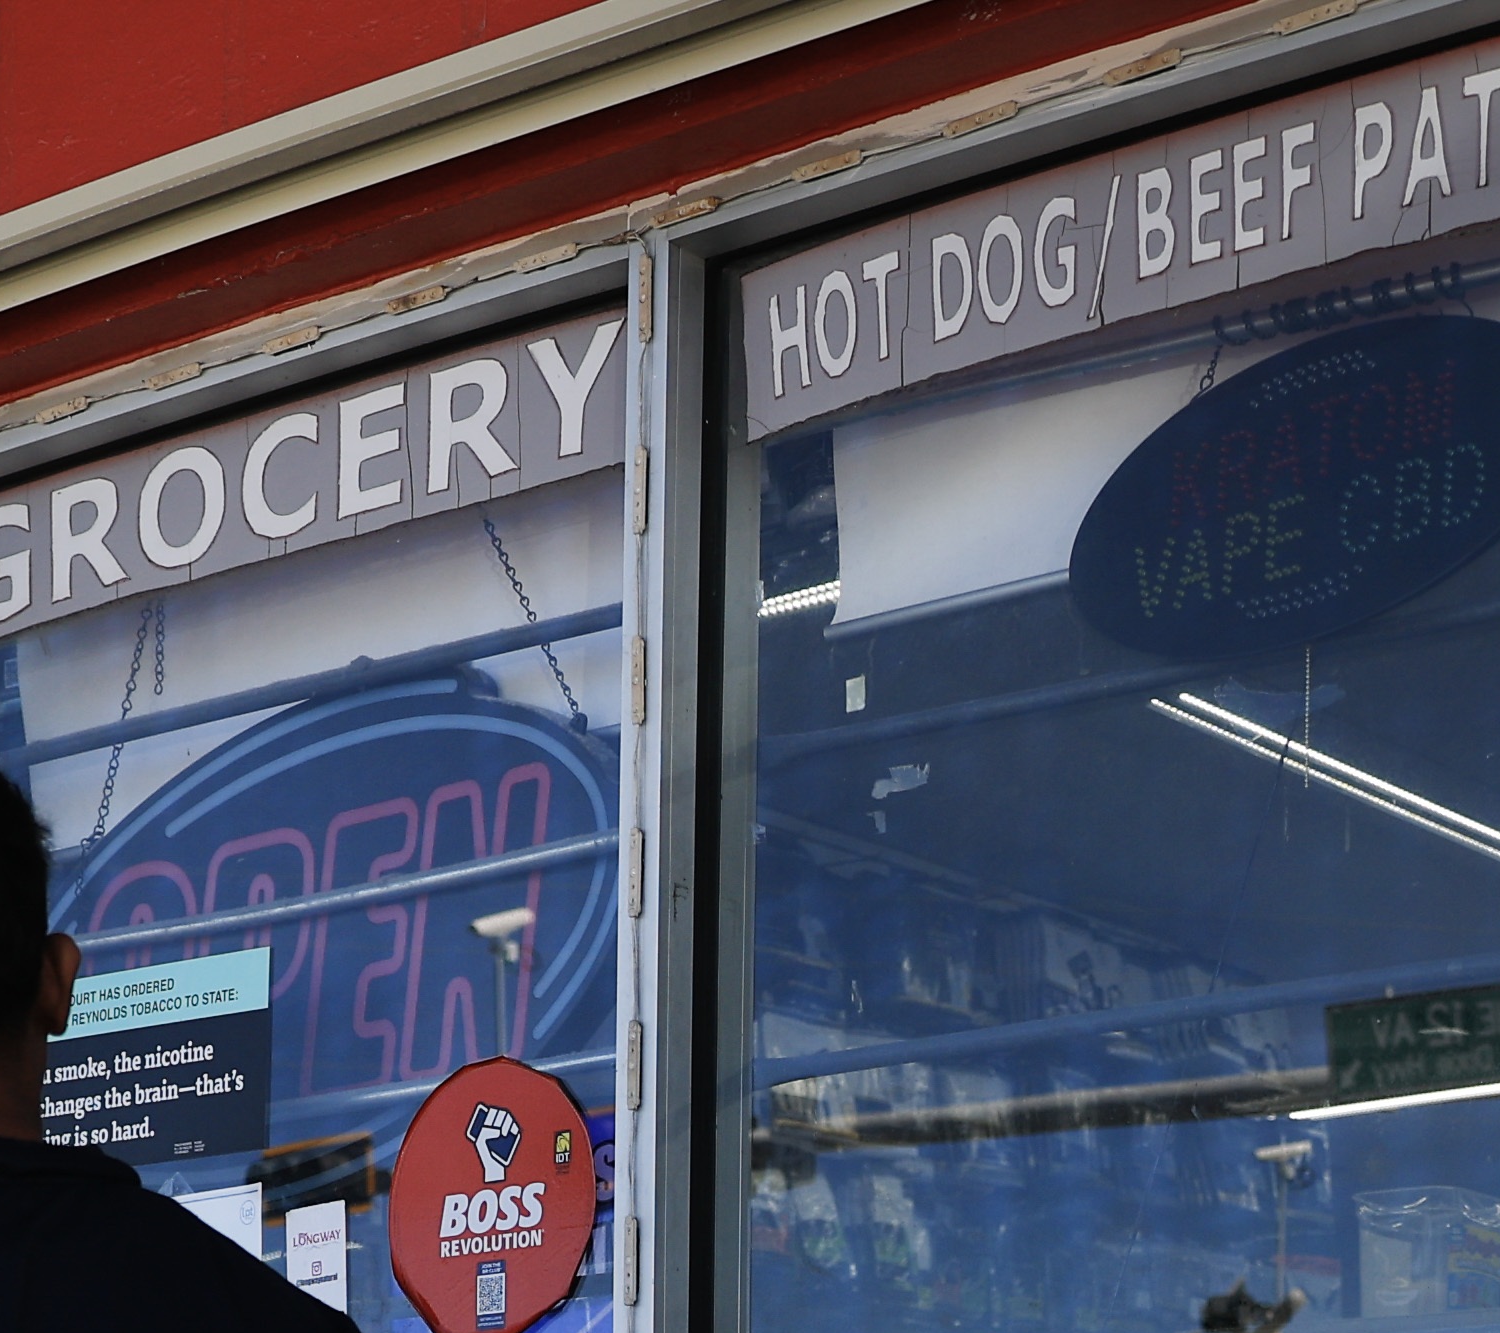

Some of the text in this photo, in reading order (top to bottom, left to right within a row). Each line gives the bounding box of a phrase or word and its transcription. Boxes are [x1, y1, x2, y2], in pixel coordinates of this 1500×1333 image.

[768, 249, 900, 397] HOT
[1171, 359, 1457, 526] KRATOM
[1134, 444, 1485, 618] VAPE CBD
[87, 761, 552, 1096] OPEN
[69, 978, 174, 1008] OURT HAS ORDERED
[72, 988, 239, 1026] REYNOLDS TOBACCO TO STATE:
[54, 1041, 213, 1082] smoke, the nicotine
[104, 1087, 131, 1109] the
[74, 1117, 154, 1146] is so hard.
[555, 1152, 570, 1163] IDT
[439, 1182, 546, 1238] BOSS
[293, 1229, 341, 1248] LONGWAY
[440, 1230, 543, 1258] REVOLUTION
